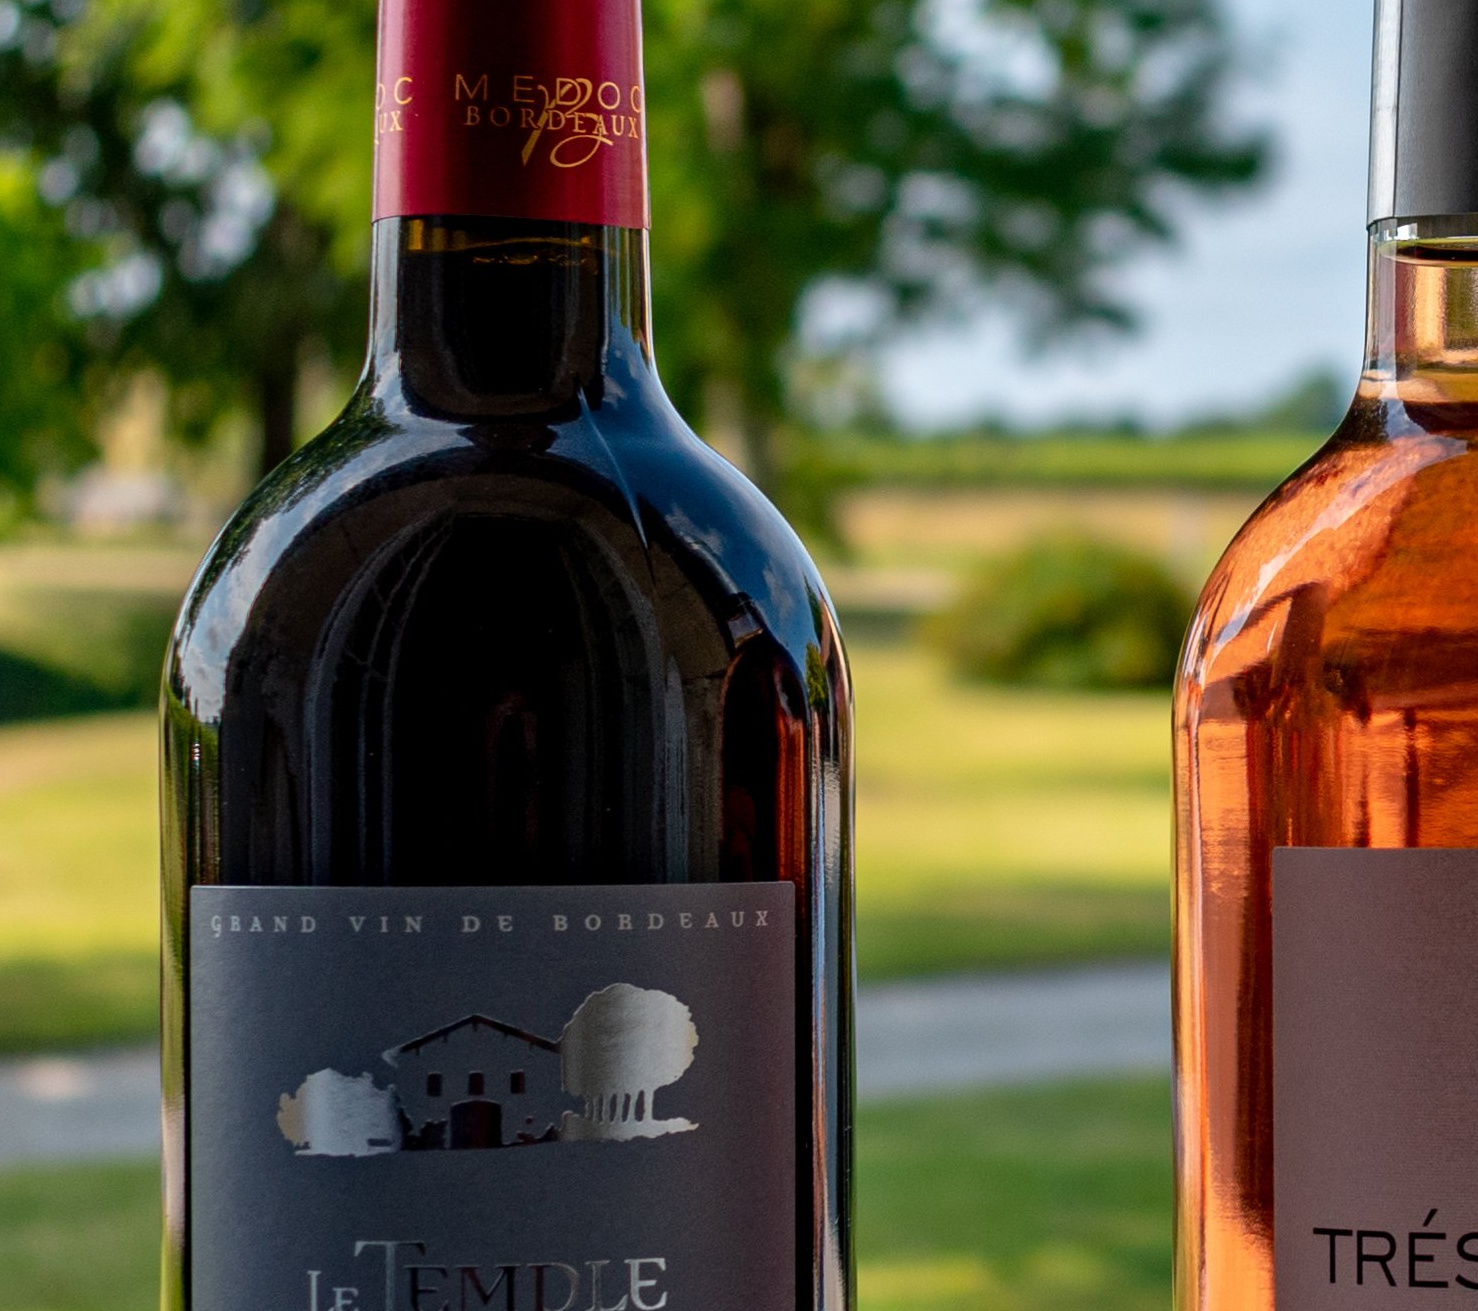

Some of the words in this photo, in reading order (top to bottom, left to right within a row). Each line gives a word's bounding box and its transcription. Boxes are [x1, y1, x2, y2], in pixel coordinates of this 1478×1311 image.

[464, 105, 639, 139] BORDEAUX
[211, 914, 318, 938] GRAND
[349, 915, 424, 934] VIN
[461, 914, 514, 933] DE
[553, 909, 771, 933] BORDEAUX
